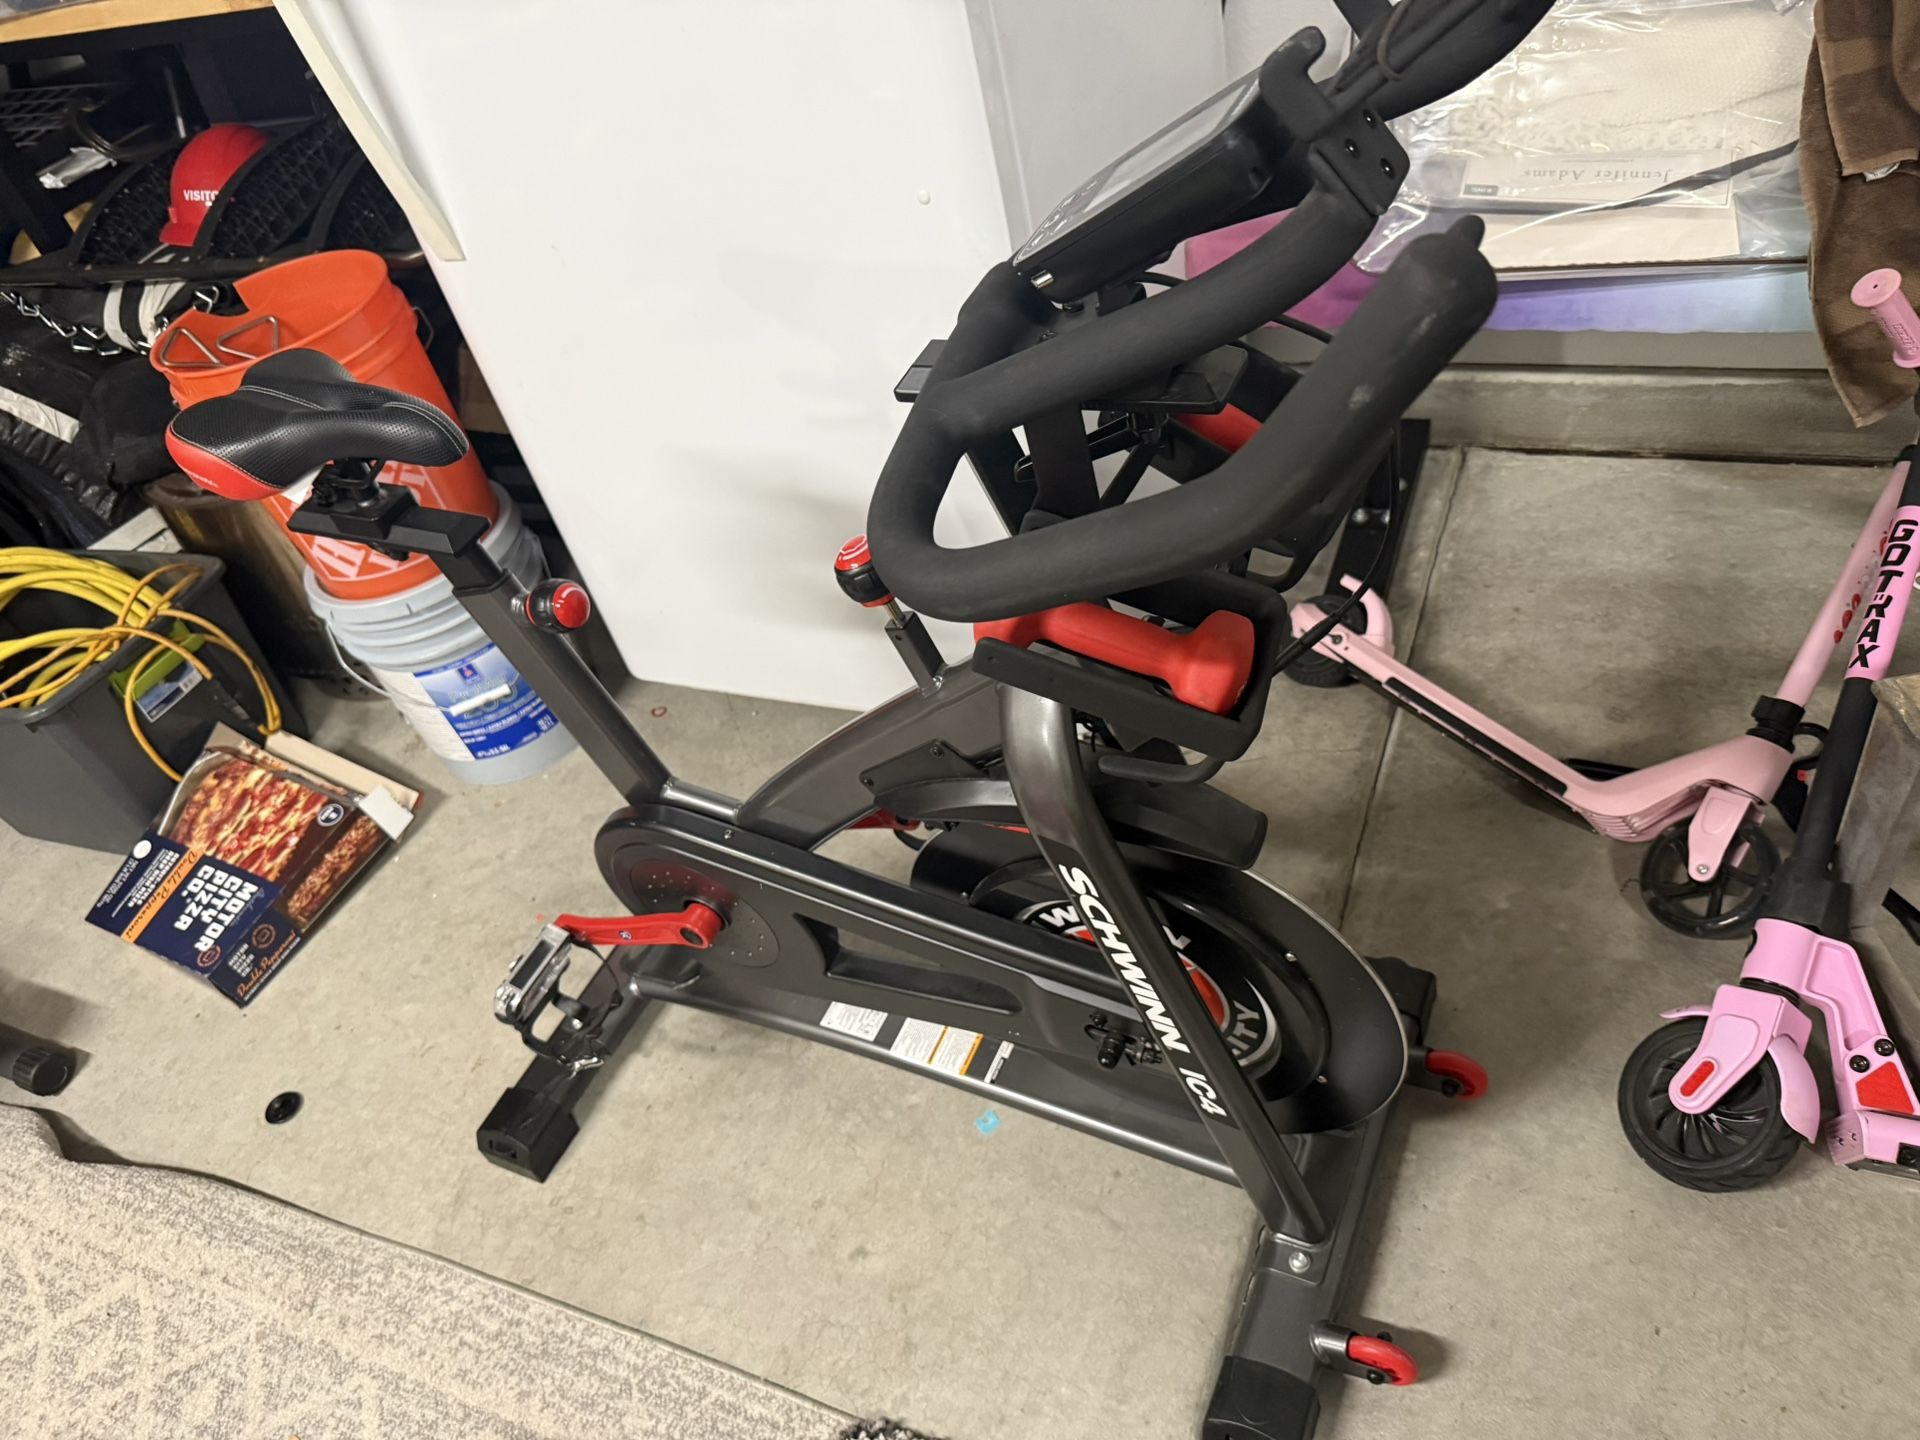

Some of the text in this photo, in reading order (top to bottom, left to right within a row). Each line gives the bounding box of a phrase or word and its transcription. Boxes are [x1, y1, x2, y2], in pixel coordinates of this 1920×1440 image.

[1521, 168, 1674, 183] Jennifer Adams
[1848, 518, 1919, 668] GOTRAX
[174, 869, 229, 931] PIZZA
[181, 864, 215, 897] CO.
[200, 875, 243, 924] CITY
[194, 881, 259, 952] MOTOR
[1058, 864, 1191, 1054] SCHWINN
[1179, 1067, 1228, 1118] IC4
